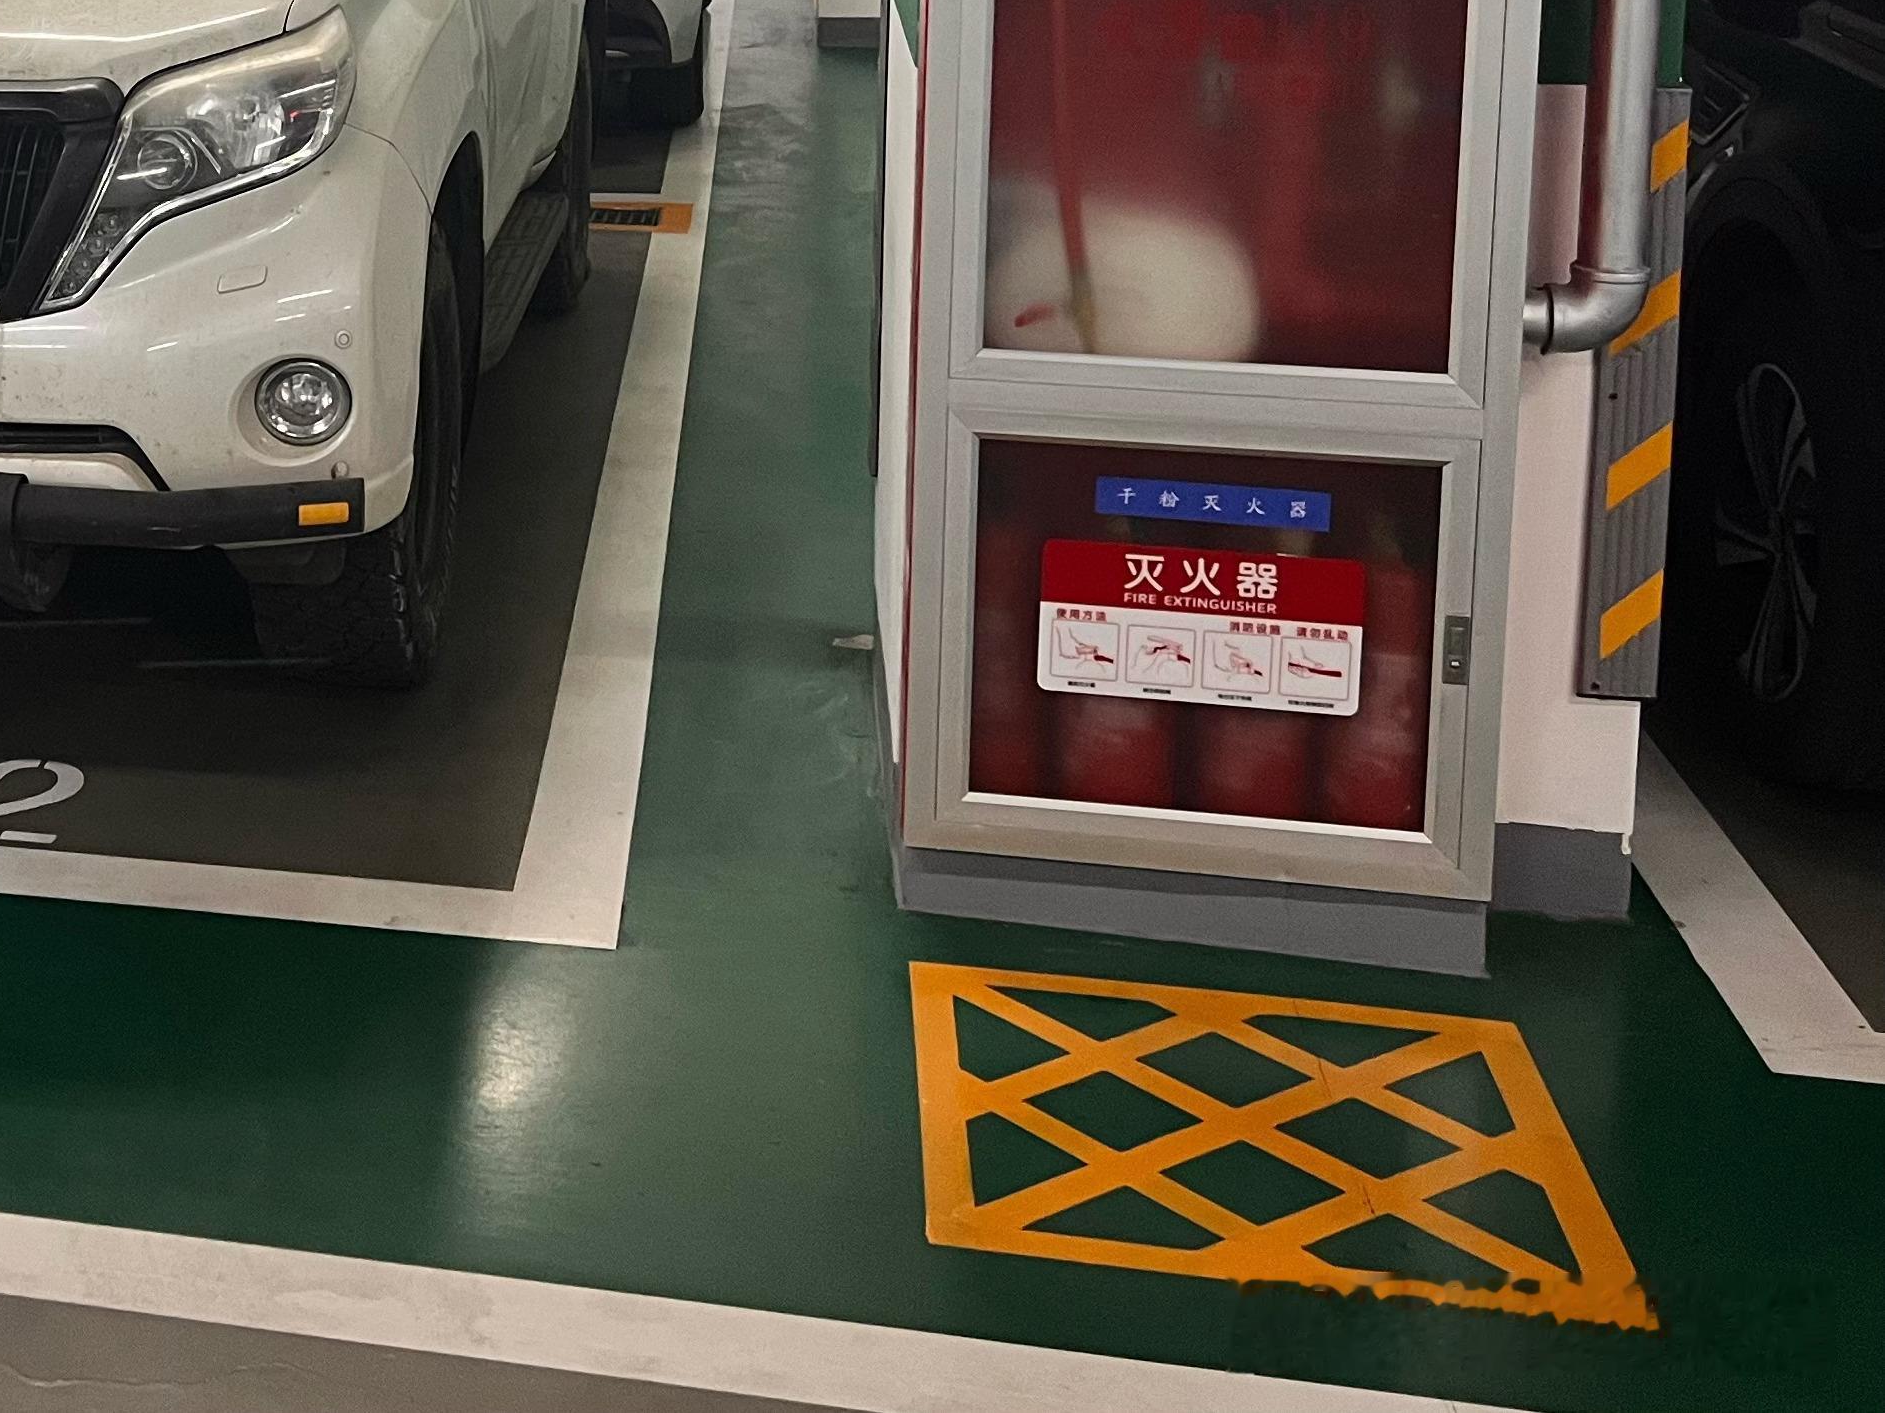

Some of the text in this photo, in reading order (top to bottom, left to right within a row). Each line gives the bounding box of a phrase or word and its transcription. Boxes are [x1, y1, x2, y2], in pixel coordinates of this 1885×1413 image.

[1124, 553, 1278, 599] 灭火器
[1123, 592, 1278, 614] FIRE EXTINGUISHER
